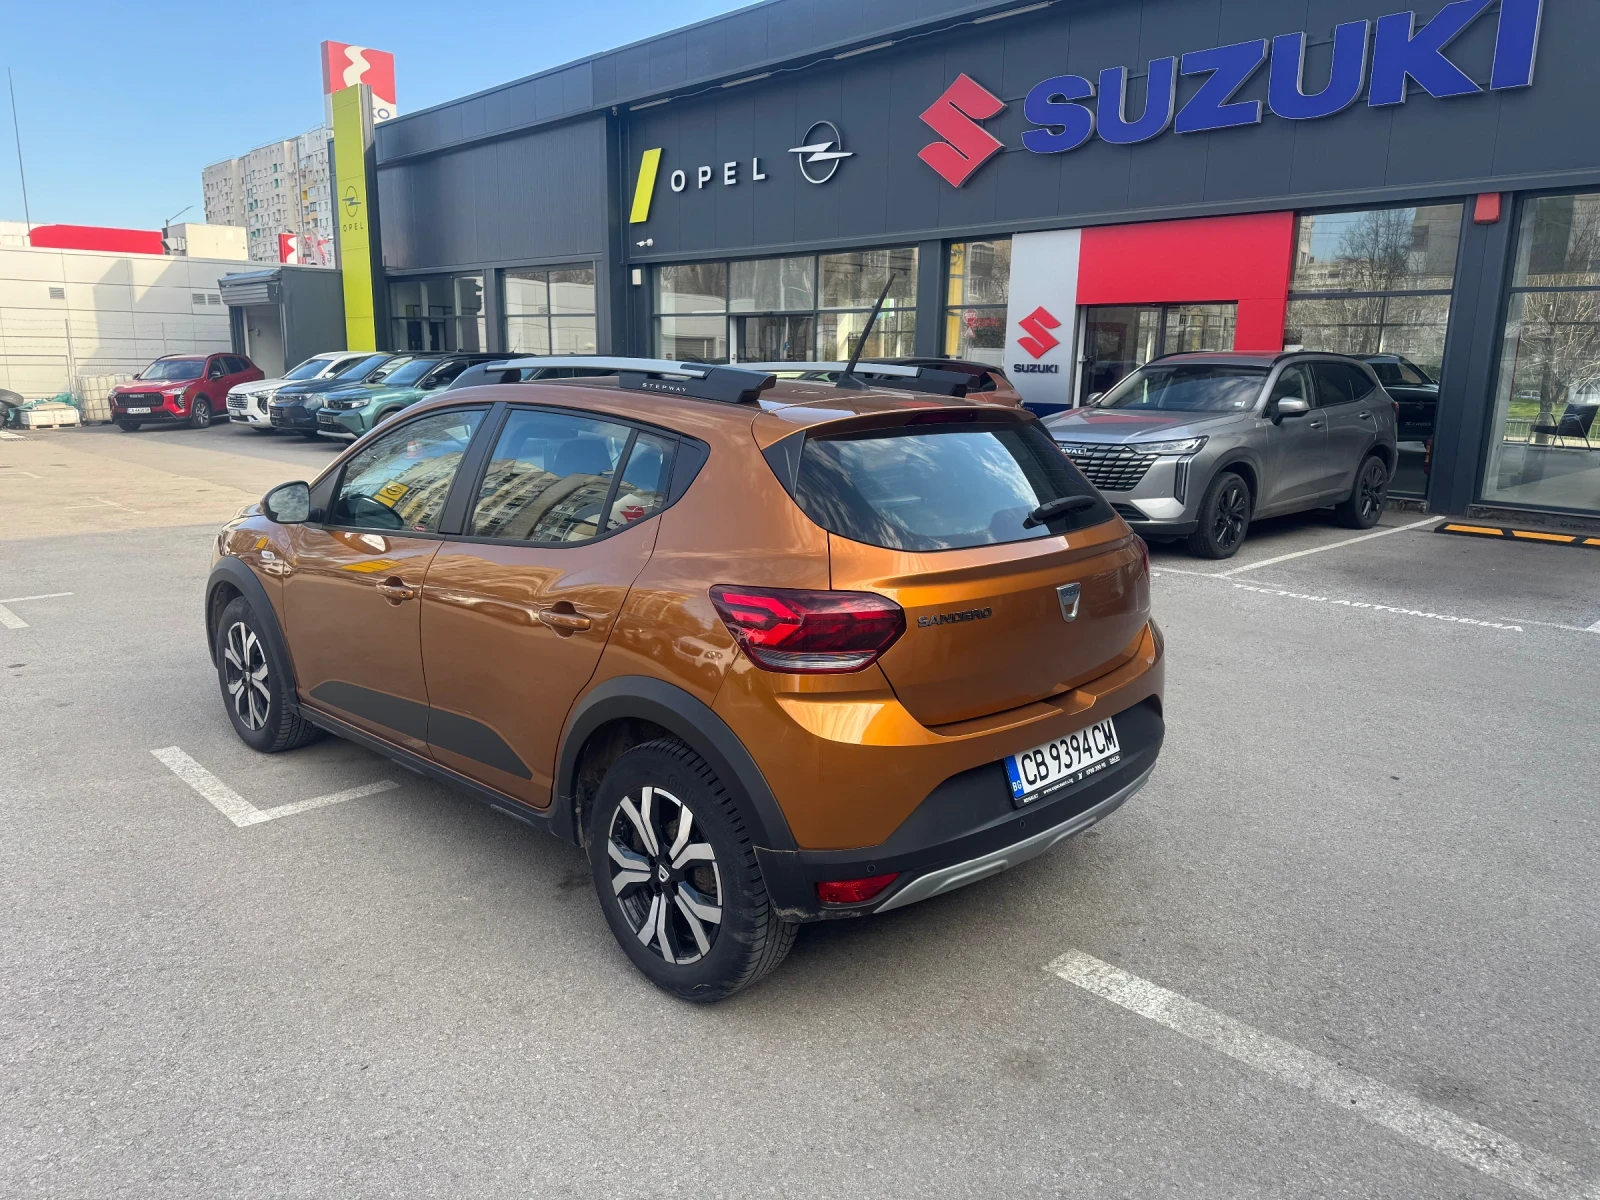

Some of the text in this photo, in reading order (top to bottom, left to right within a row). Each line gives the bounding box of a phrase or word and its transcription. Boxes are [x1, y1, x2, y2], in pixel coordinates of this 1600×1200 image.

[1021, 0, 1544, 154] SUZUKI
[670, 157, 766, 192] OPEL
[342, 221, 364, 232] OPEL
[1013, 363, 1059, 374] SUZUKI
[642, 382, 688, 392] STEPWAY
[1060, 447, 1084, 455] AVAL
[917, 607, 993, 628] SANDERO
[1021, 719, 1118, 786] CB 9394 CM
[1011, 779, 1022, 792] BG
